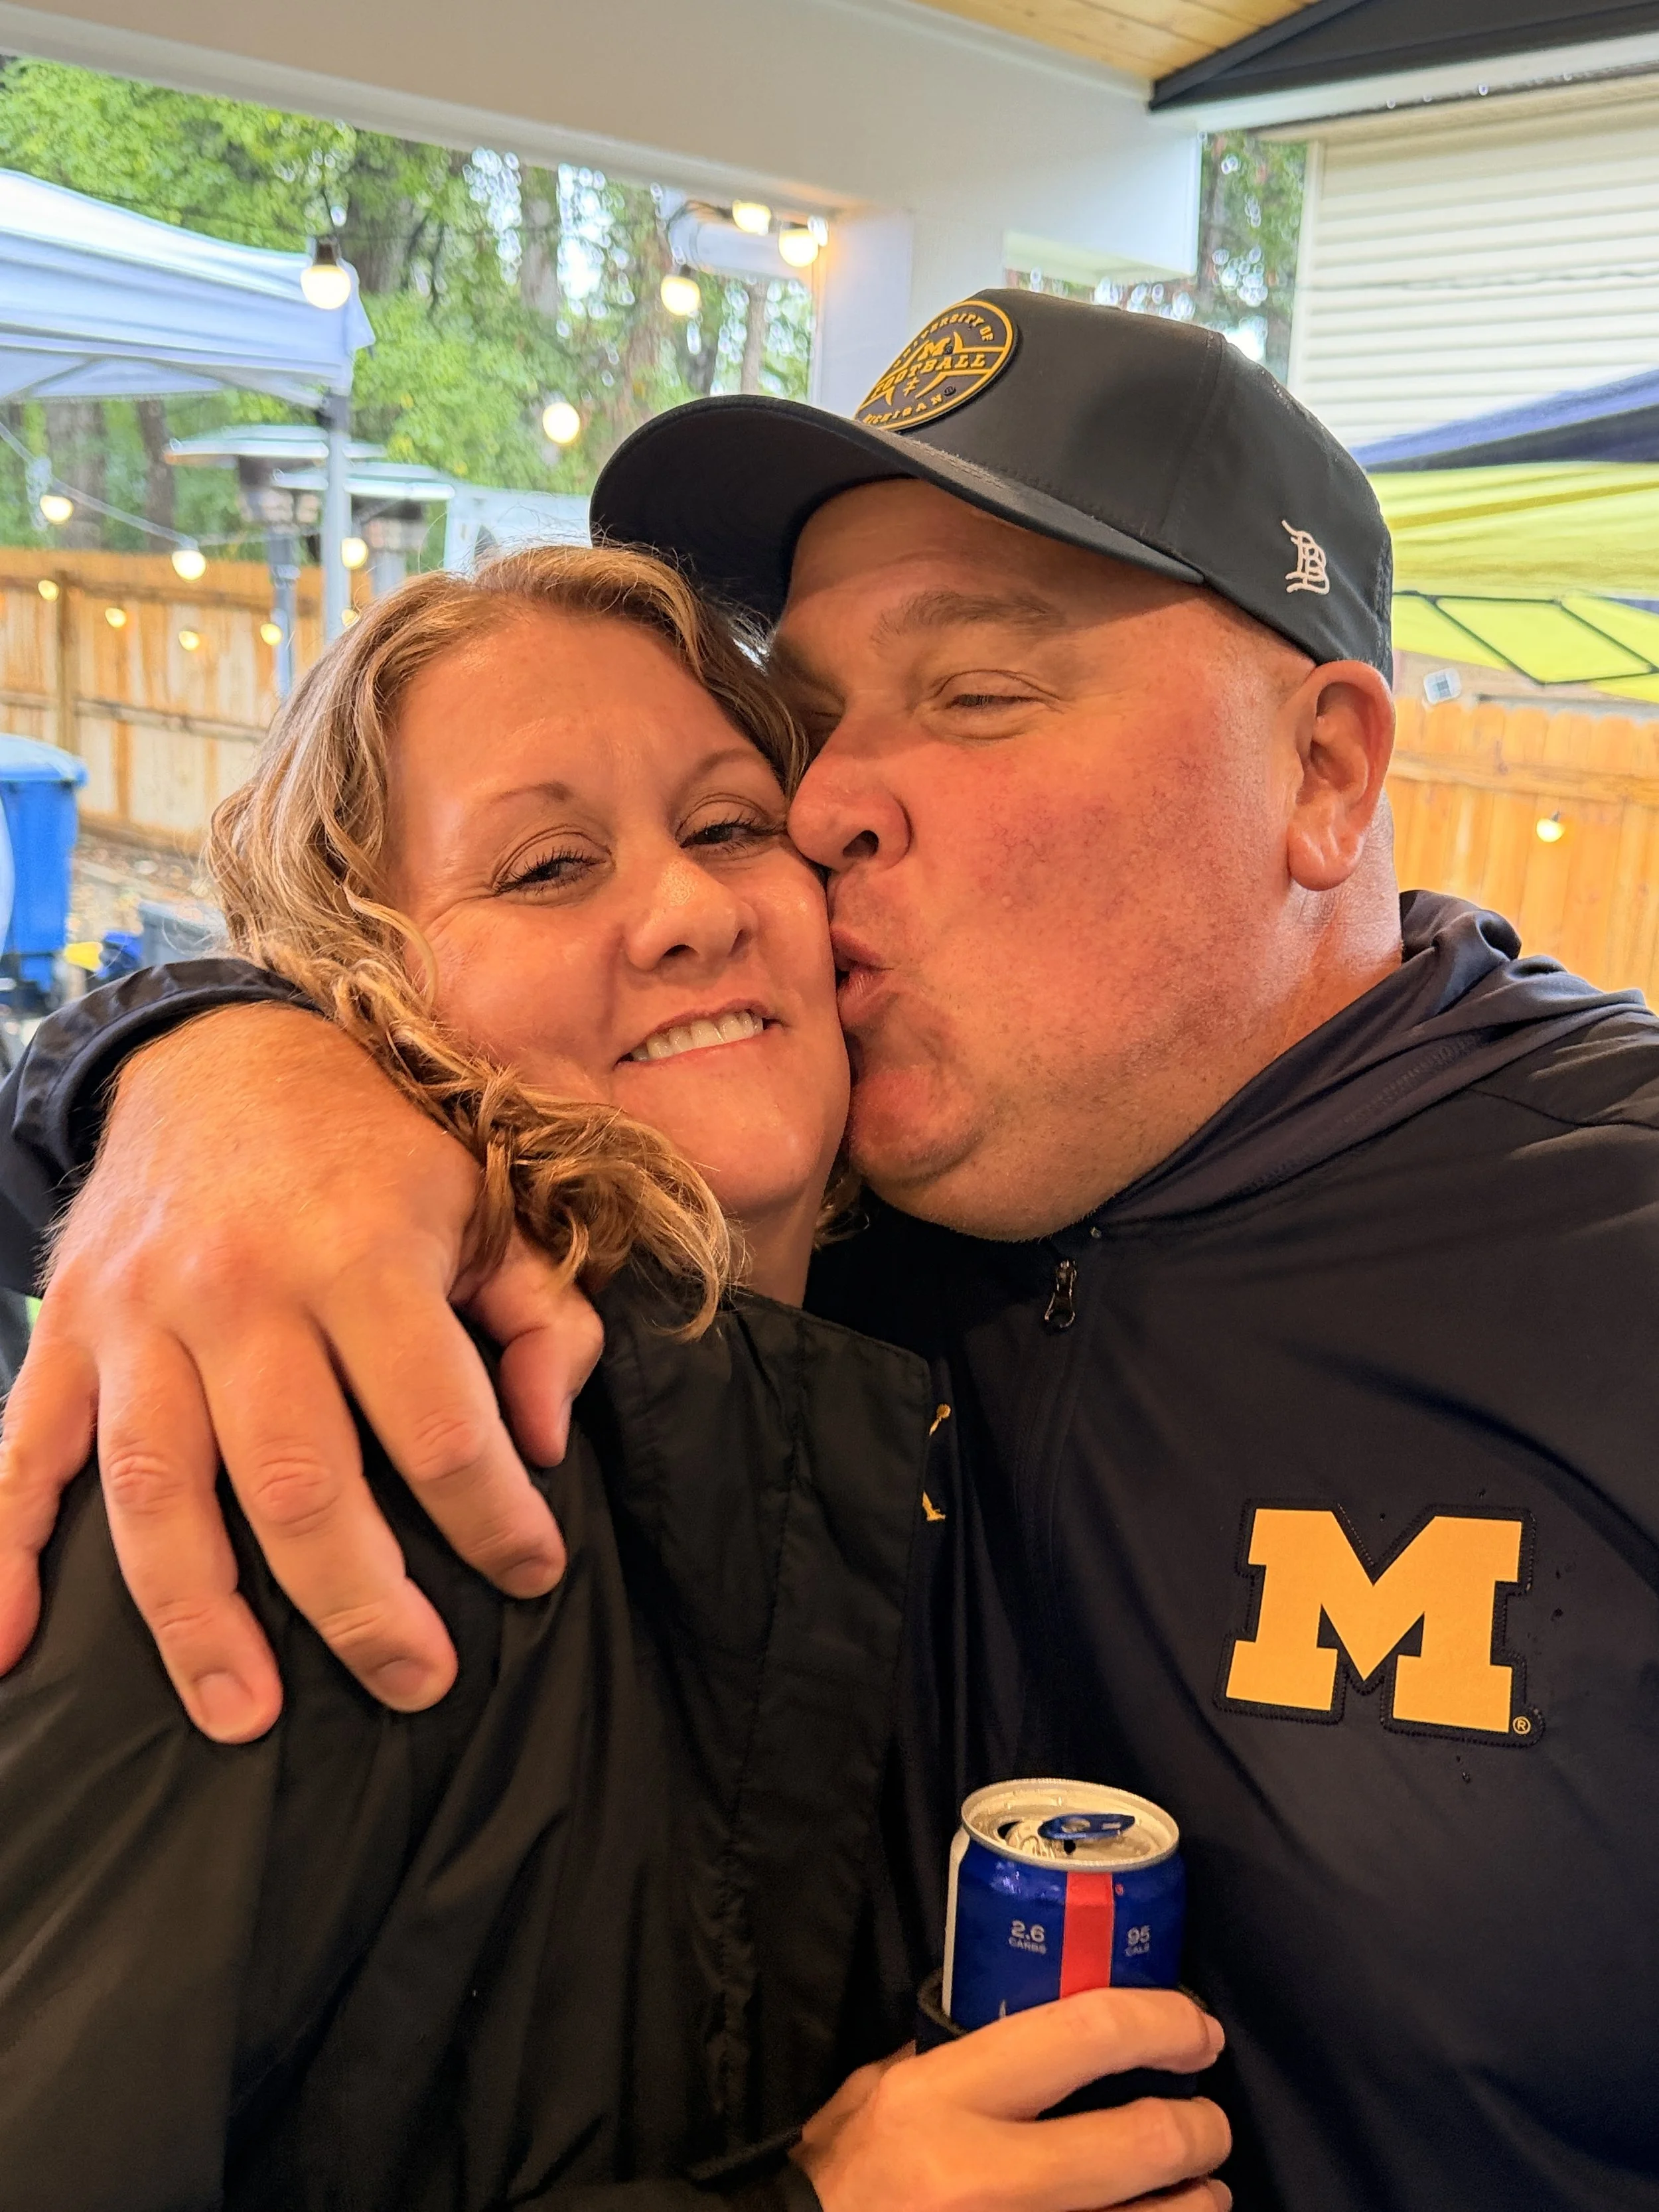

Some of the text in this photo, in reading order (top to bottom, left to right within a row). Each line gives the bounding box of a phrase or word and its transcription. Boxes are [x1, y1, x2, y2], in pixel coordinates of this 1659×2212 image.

[979, 325, 994, 341] OF
[871, 354, 985, 399] FOOTBALL
[1226, 1509, 1522, 1733] M
[1011, 1919, 1045, 1943] 2.6
[1127, 1925, 1150, 1945] 95
